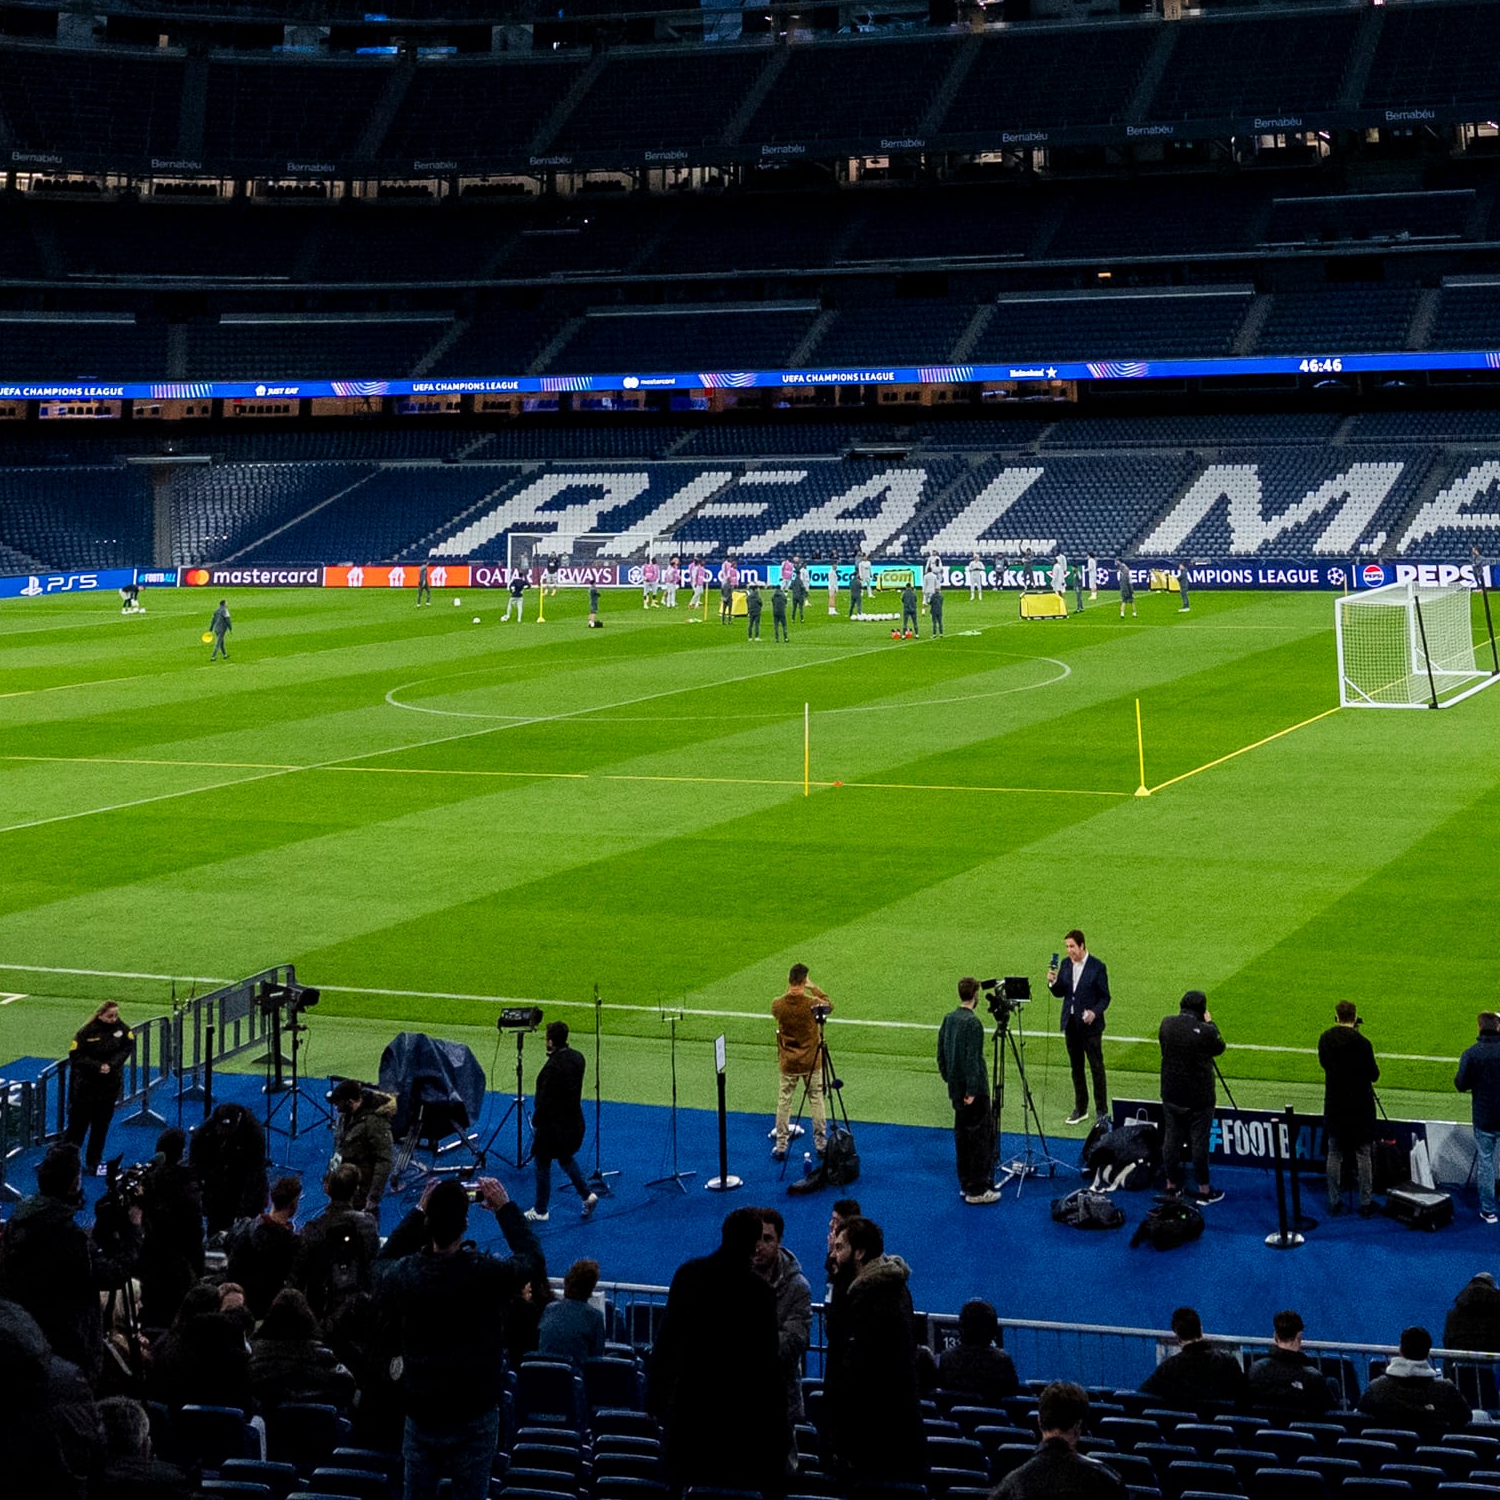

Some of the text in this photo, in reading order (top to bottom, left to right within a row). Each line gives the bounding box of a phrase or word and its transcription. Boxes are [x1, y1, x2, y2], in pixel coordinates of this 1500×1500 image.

[1385, 109, 1435, 121] Bernabéu
[1253, 116, 1302, 128] Bernabéu
[1126, 124, 1174, 135] Bernabéu
[1002, 131, 1048, 143] Bernabéu
[761, 144, 805, 155] Bernabéu
[881, 138, 925, 149] Bernabéu
[11, 152, 62, 164] Bernabéu
[529, 155, 572, 166] Bernabéu
[644, 149, 688, 160] Bernabéu
[151, 159, 201, 170] Bernabéu
[286, 162, 335, 172] Bernabéu
[413, 160, 457, 170] Bernabéu
[1299, 359, 1342, 372] 46:46
[782, 372, 894, 383] UEFA CHAMPIONS LEAGUE
[23, 387, 83, 396] CHAMPIONS
[84, 388, 124, 396] LEAGUE
[413, 381, 519, 392] UEFA CHAMPIONS LEAGUE
[429, 467, 1056, 557] REAL
[214, 568, 318, 584] mastercard
[476, 567, 612, 585] QATAR ARWAYS
[1160, 569, 1253, 583] HAMPIONS
[1259, 569, 1319, 583] LEAGUE
[1395, 565, 1492, 588] PEPSI
[47, 575, 97, 592] PS5
[1208, 1118, 1338, 1161] #FOOTBAL
